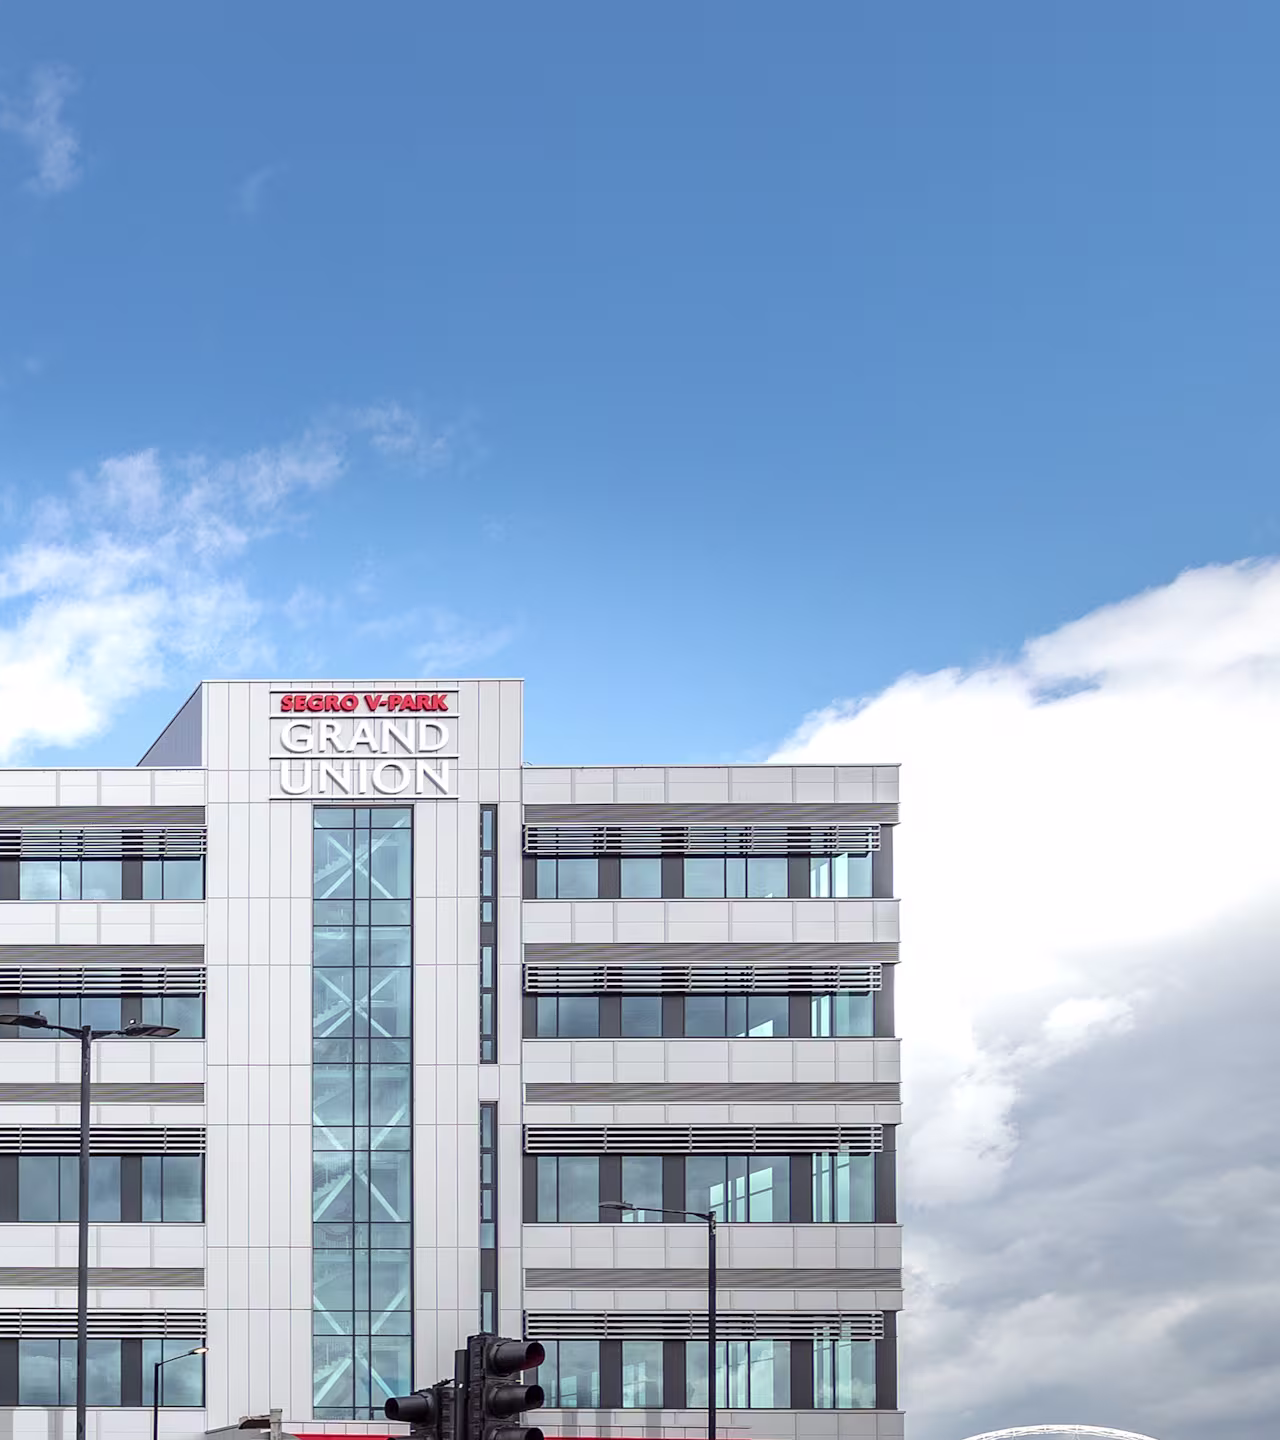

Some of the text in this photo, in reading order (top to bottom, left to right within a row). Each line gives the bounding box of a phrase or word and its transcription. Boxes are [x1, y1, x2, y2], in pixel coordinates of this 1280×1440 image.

[280, 694, 449, 712] SEGRO V-PARK
[280, 719, 450, 754] GRAND
[280, 759, 449, 795] UNION
